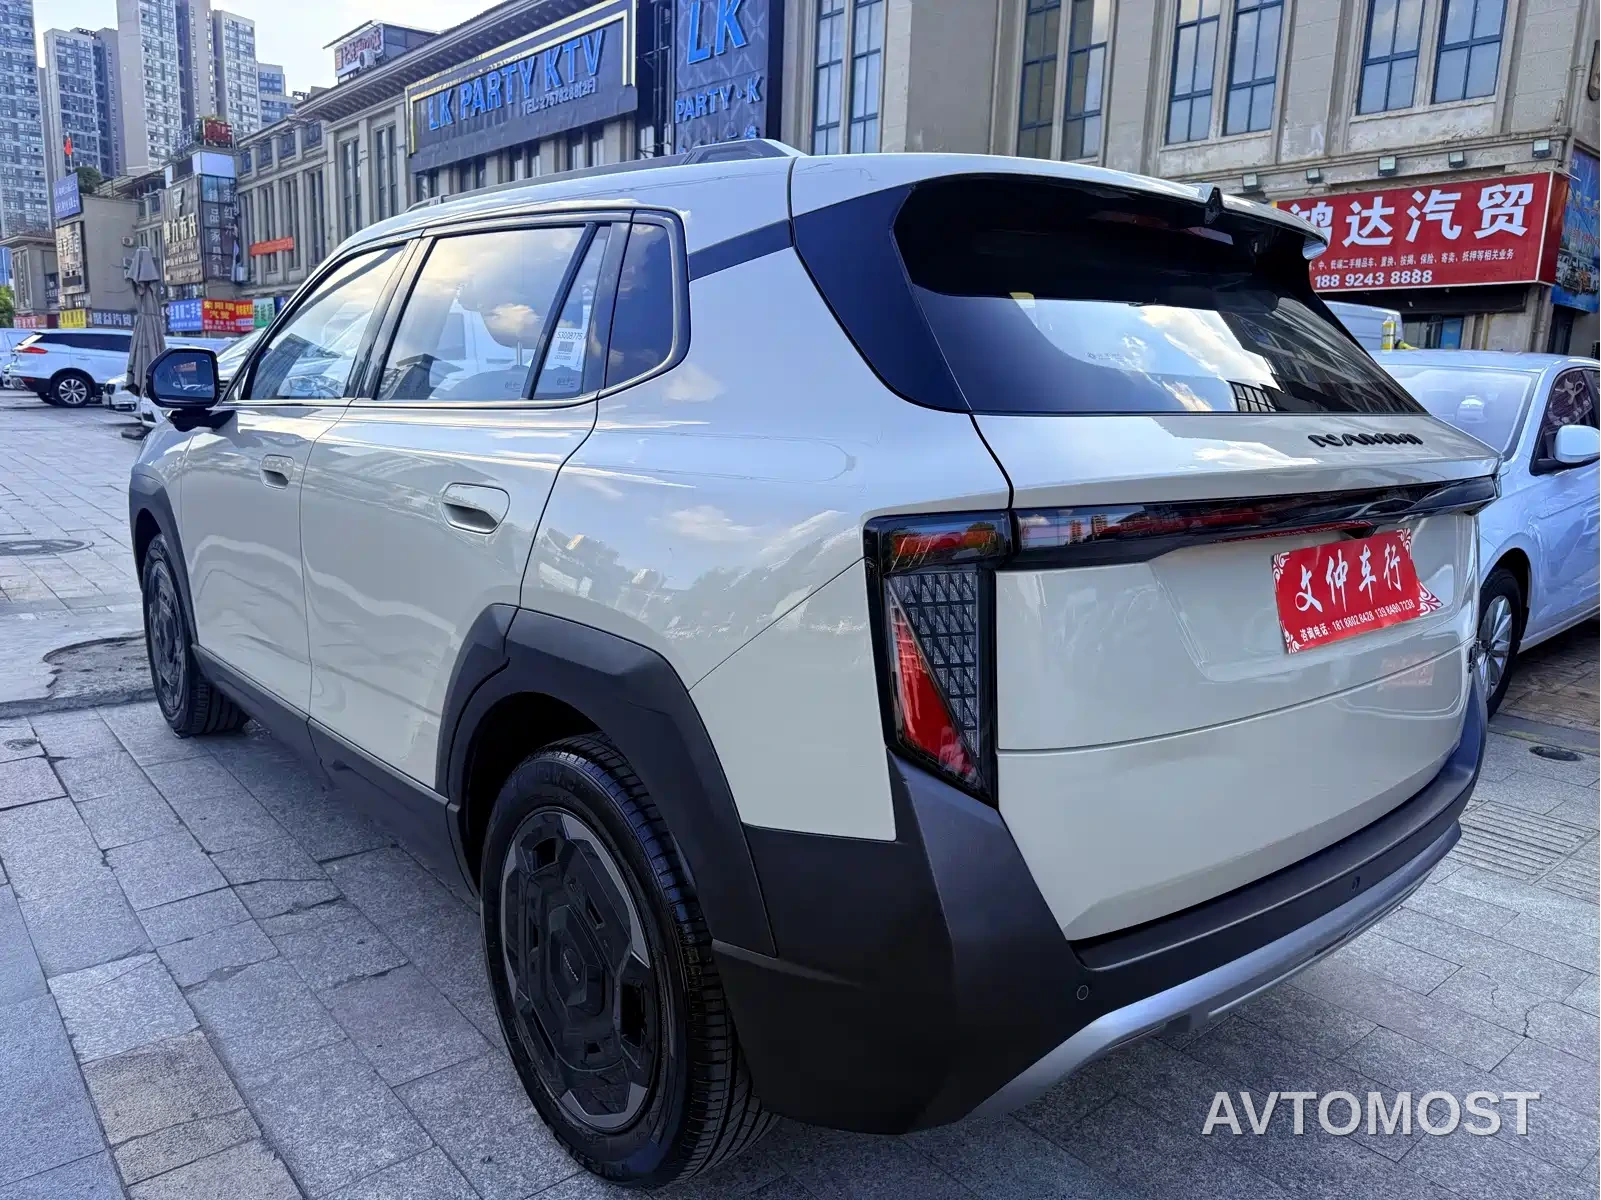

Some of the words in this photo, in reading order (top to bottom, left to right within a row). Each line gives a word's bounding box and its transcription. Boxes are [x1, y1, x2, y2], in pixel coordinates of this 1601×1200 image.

[687, 0, 747, 64] LK
[428, 87, 453, 131] LK
[460, 56, 537, 120] PARTY
[544, 29, 605, 92] KTV
[1289, 183, 1533, 247] 鸿达汽贸
[1315, 274, 1340, 288] 188
[1345, 272, 1384, 287] 9243
[1390, 269, 1432, 284] 8888
[1308, 433, 1424, 447] NAMMI
[1295, 543, 1402, 613] 文仲车行
